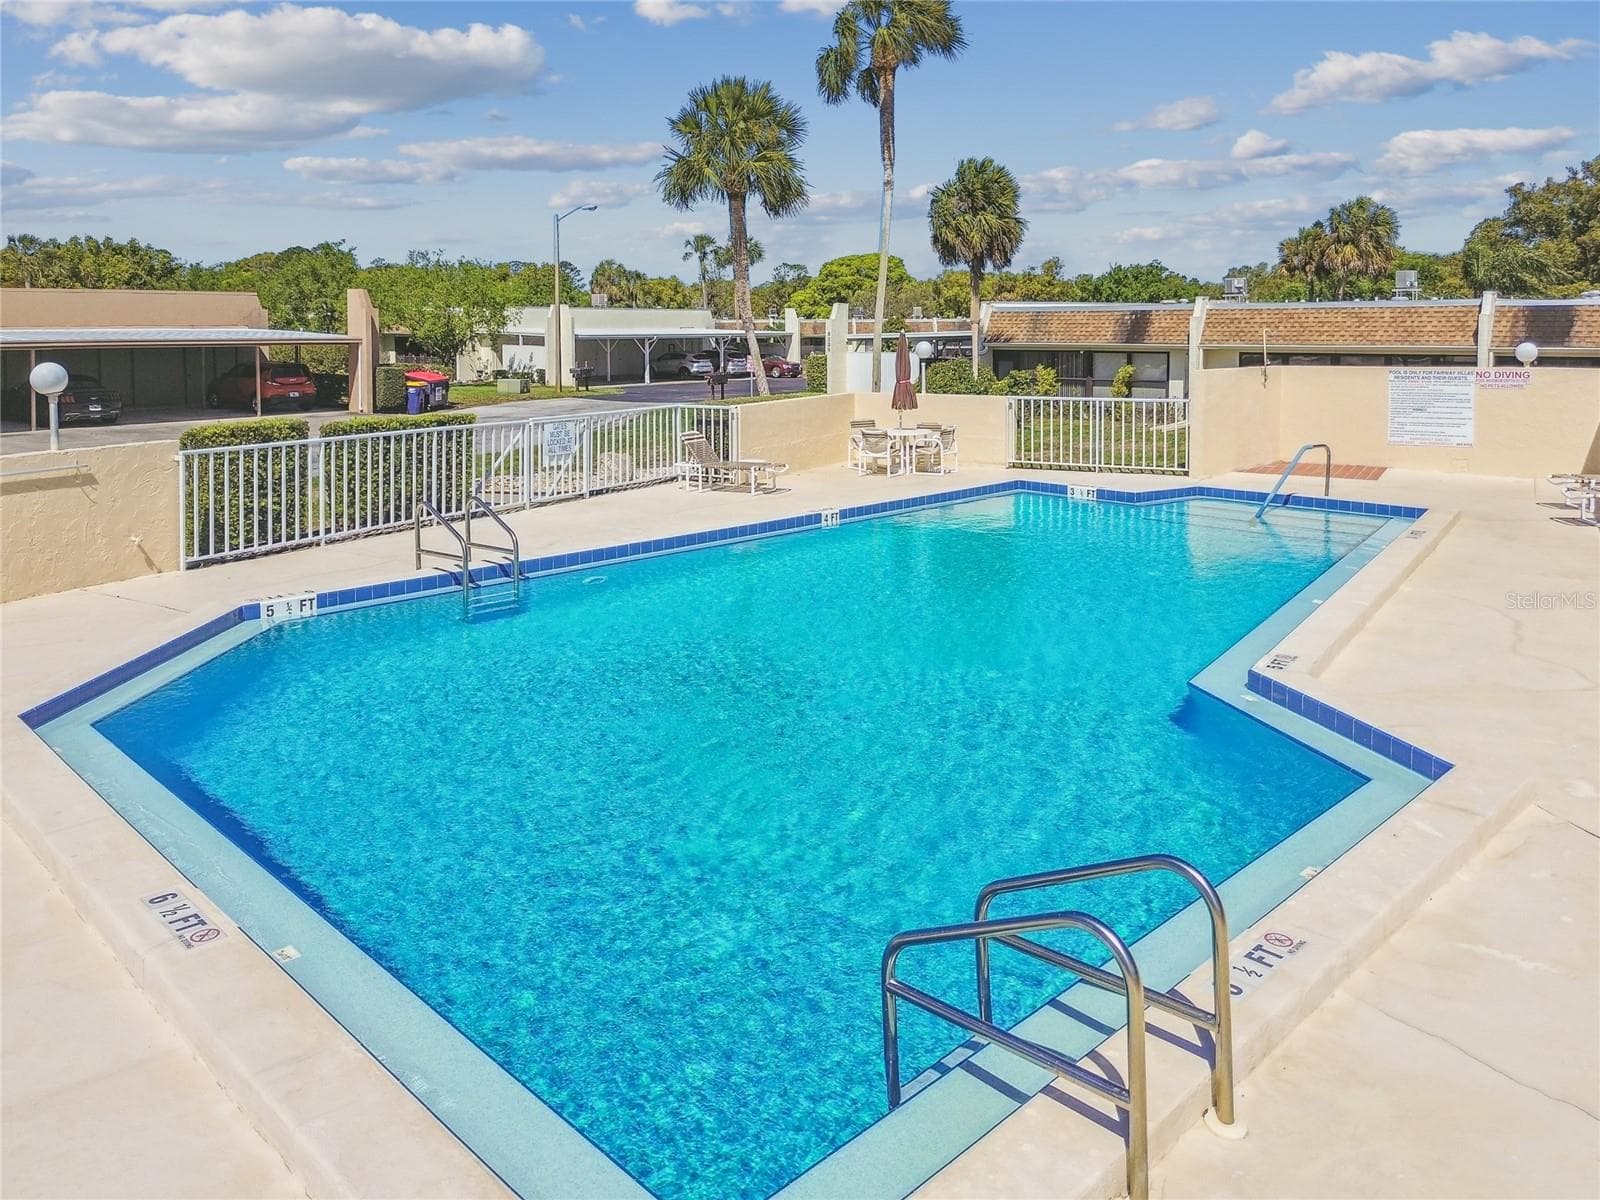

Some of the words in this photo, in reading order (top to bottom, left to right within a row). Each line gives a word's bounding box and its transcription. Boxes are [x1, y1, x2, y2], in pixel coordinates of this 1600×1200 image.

[1070, 488, 1075, 496] 3
[1087, 490, 1095, 499] FT
[266, 605, 275, 617] 5
[300, 598, 315, 612] FT
[148, 892, 178, 905] 6
[168, 913, 208, 932] FT
[1244, 944, 1284, 968] FT
